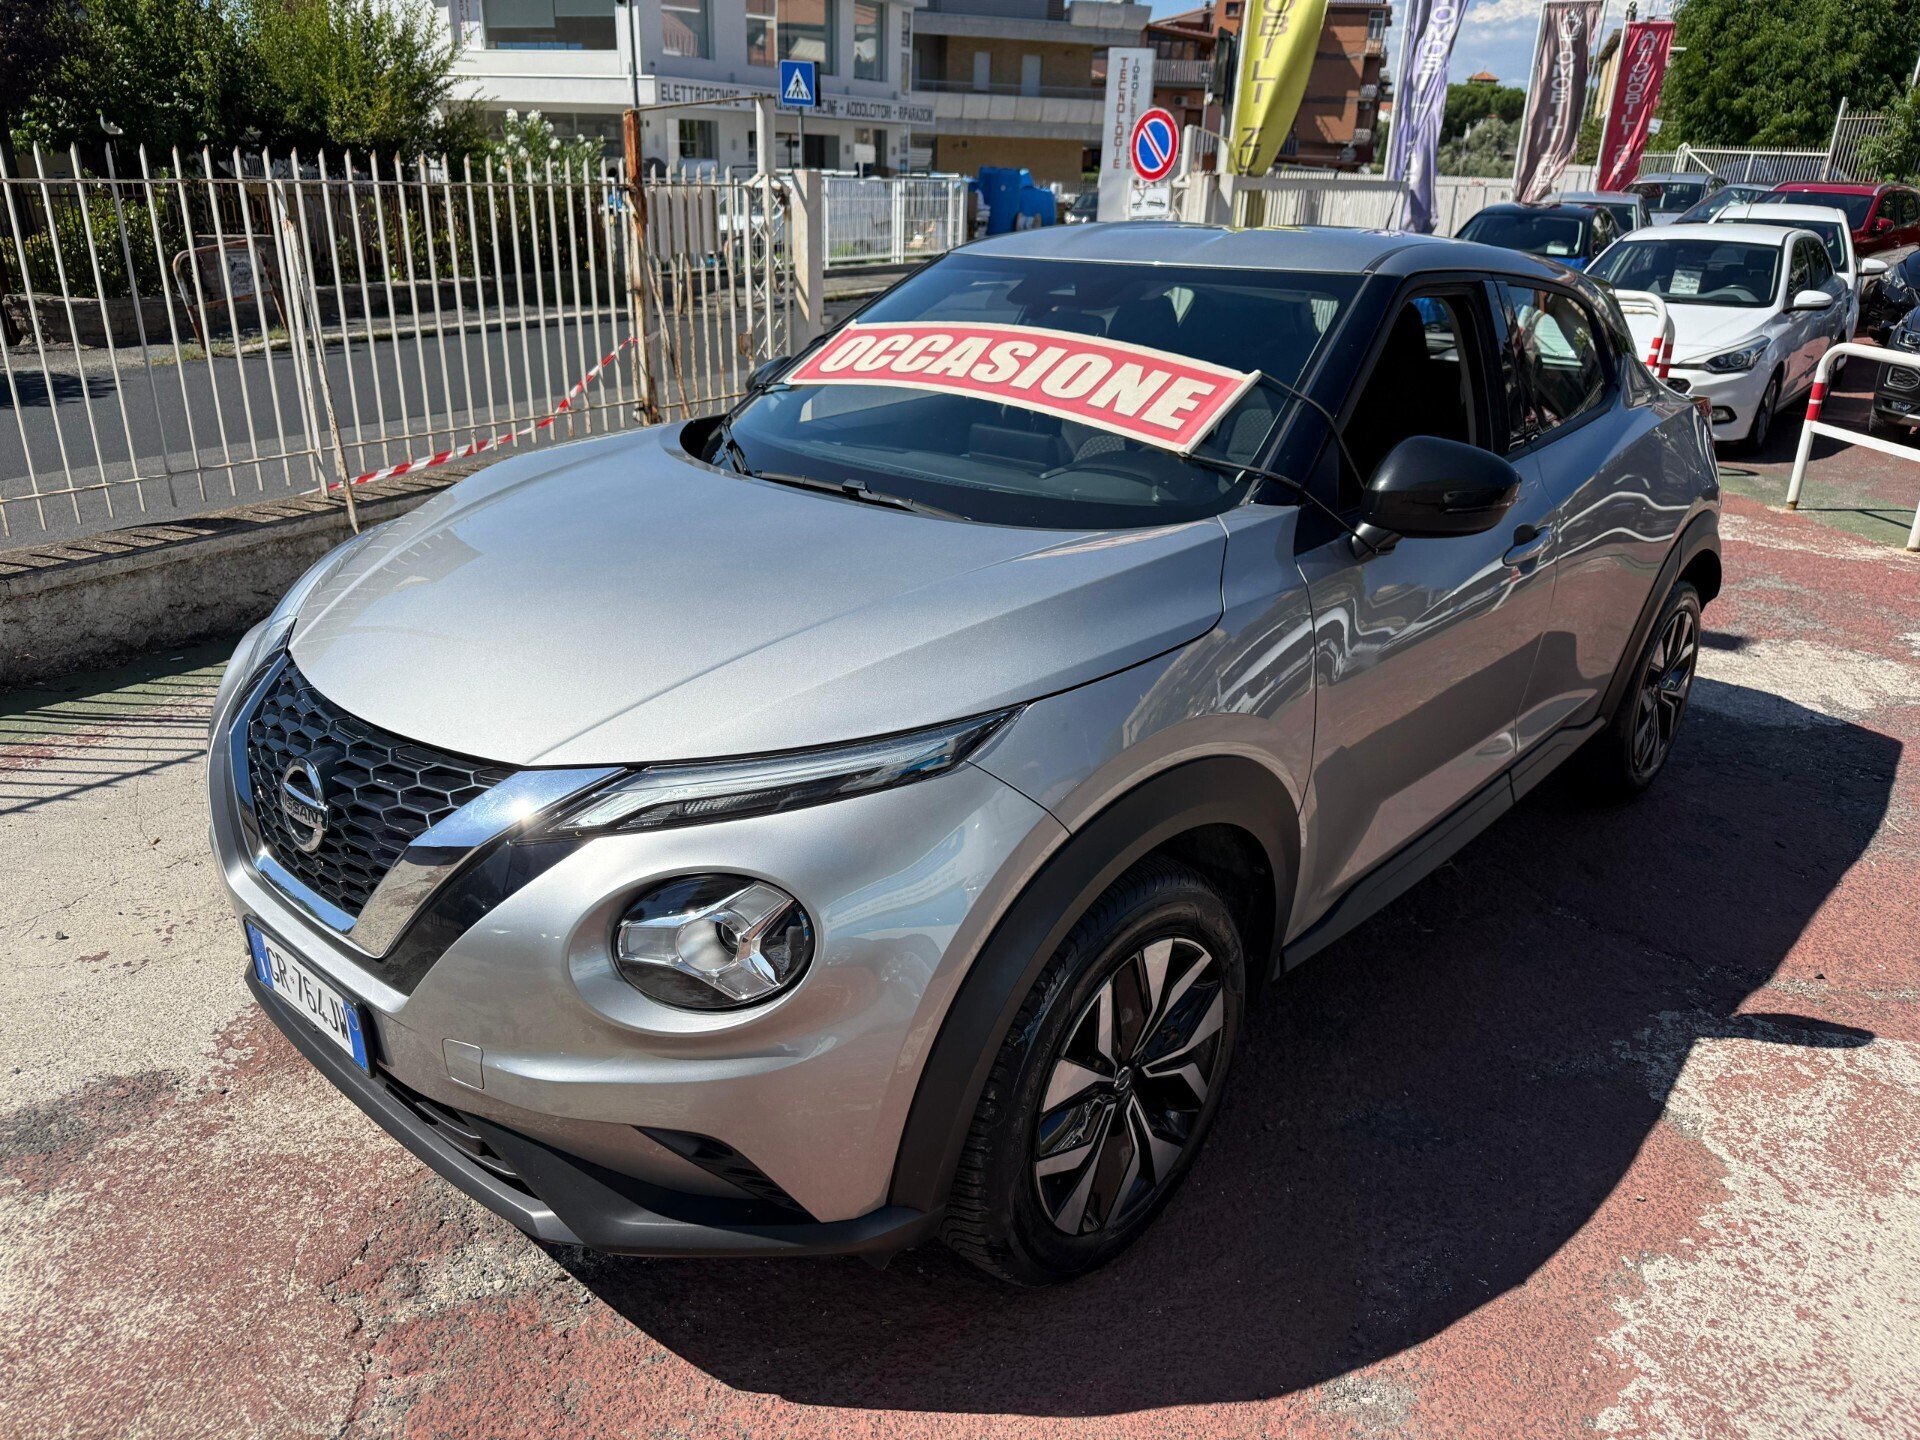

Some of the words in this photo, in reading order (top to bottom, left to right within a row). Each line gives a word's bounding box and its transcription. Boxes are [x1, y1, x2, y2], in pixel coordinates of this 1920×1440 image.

[1113, 57, 1129, 169] TECNOLOGIE
[1621, 31, 1657, 135] AUTOMOBILI
[818, 333, 1216, 430] OCCASIONE
